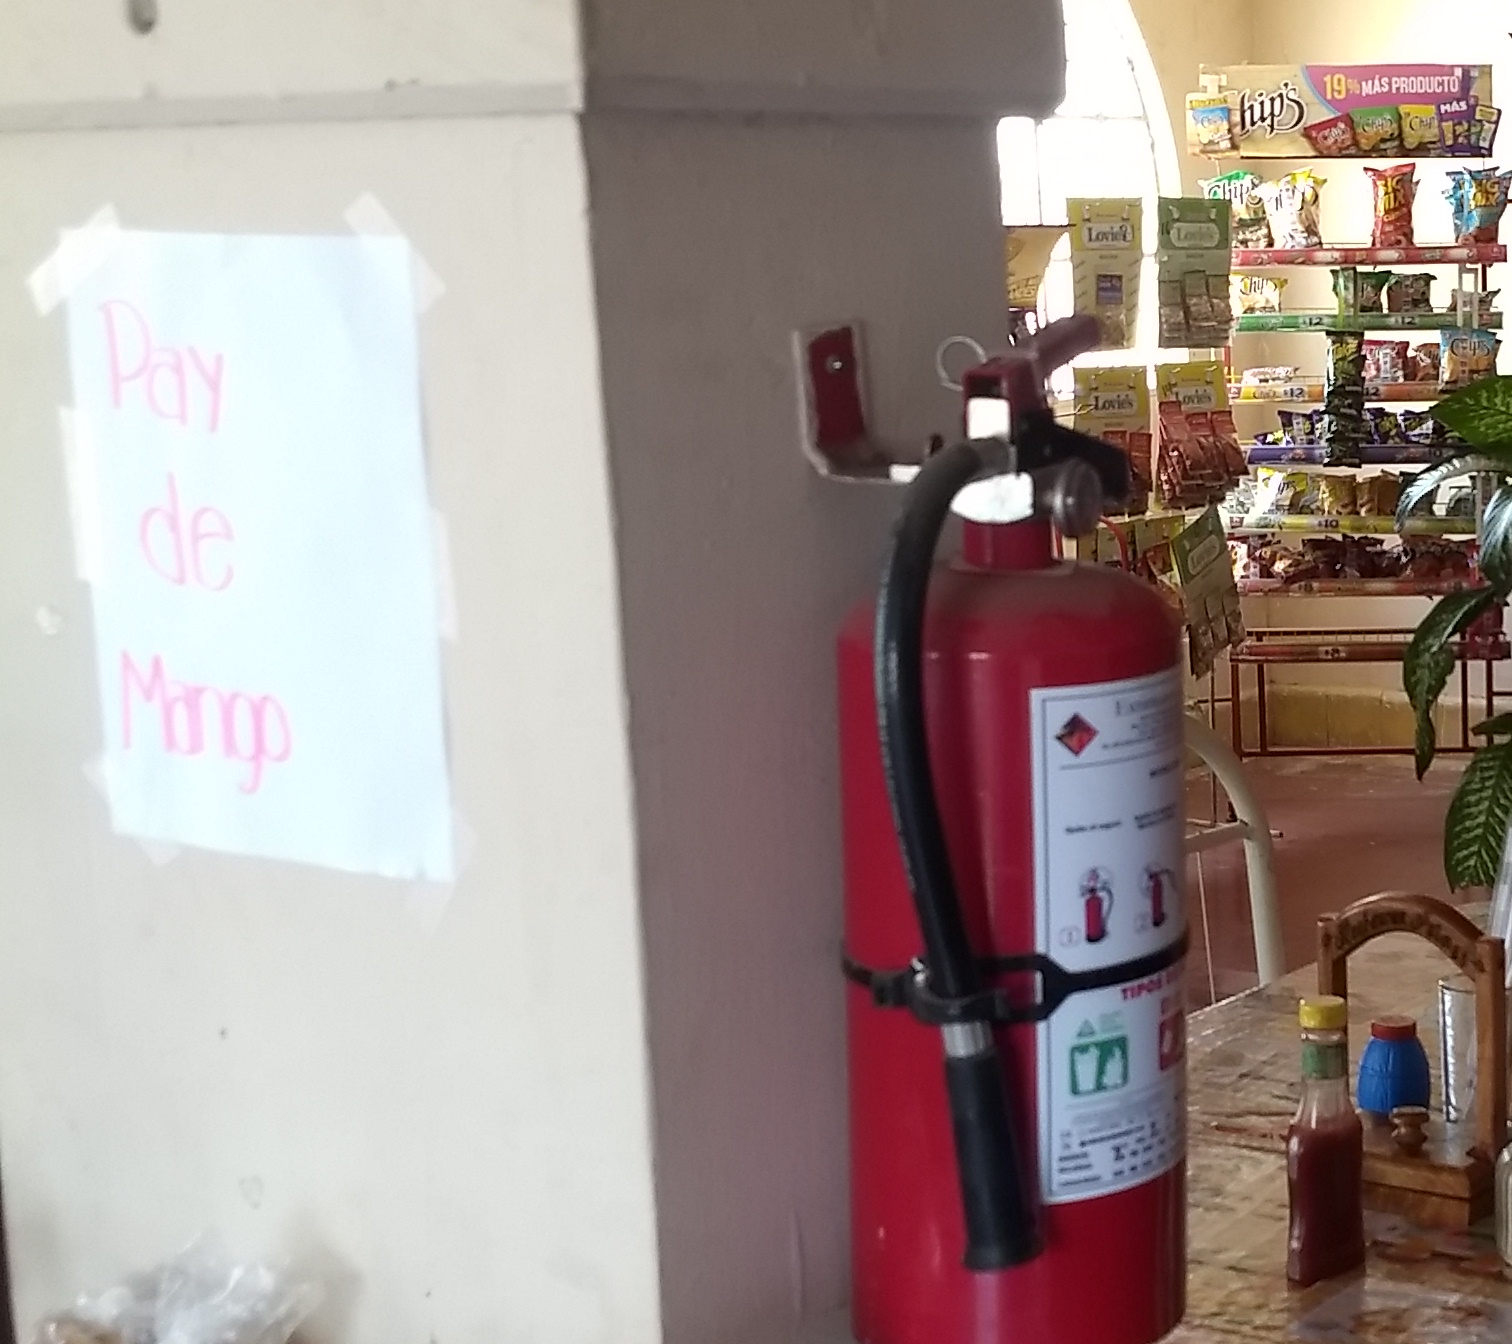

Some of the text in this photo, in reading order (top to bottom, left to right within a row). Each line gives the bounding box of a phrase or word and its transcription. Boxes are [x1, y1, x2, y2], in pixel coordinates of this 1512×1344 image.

[1361, 73, 1389, 96] MÁS
[1391, 73, 1461, 94] PRODUCTO
[1440, 99, 1468, 114] MÁS
[98, 298, 225, 433] Pay
[1363, 386, 1380, 397] 12
[138, 471, 236, 592] de
[119, 649, 292, 795] Mango
